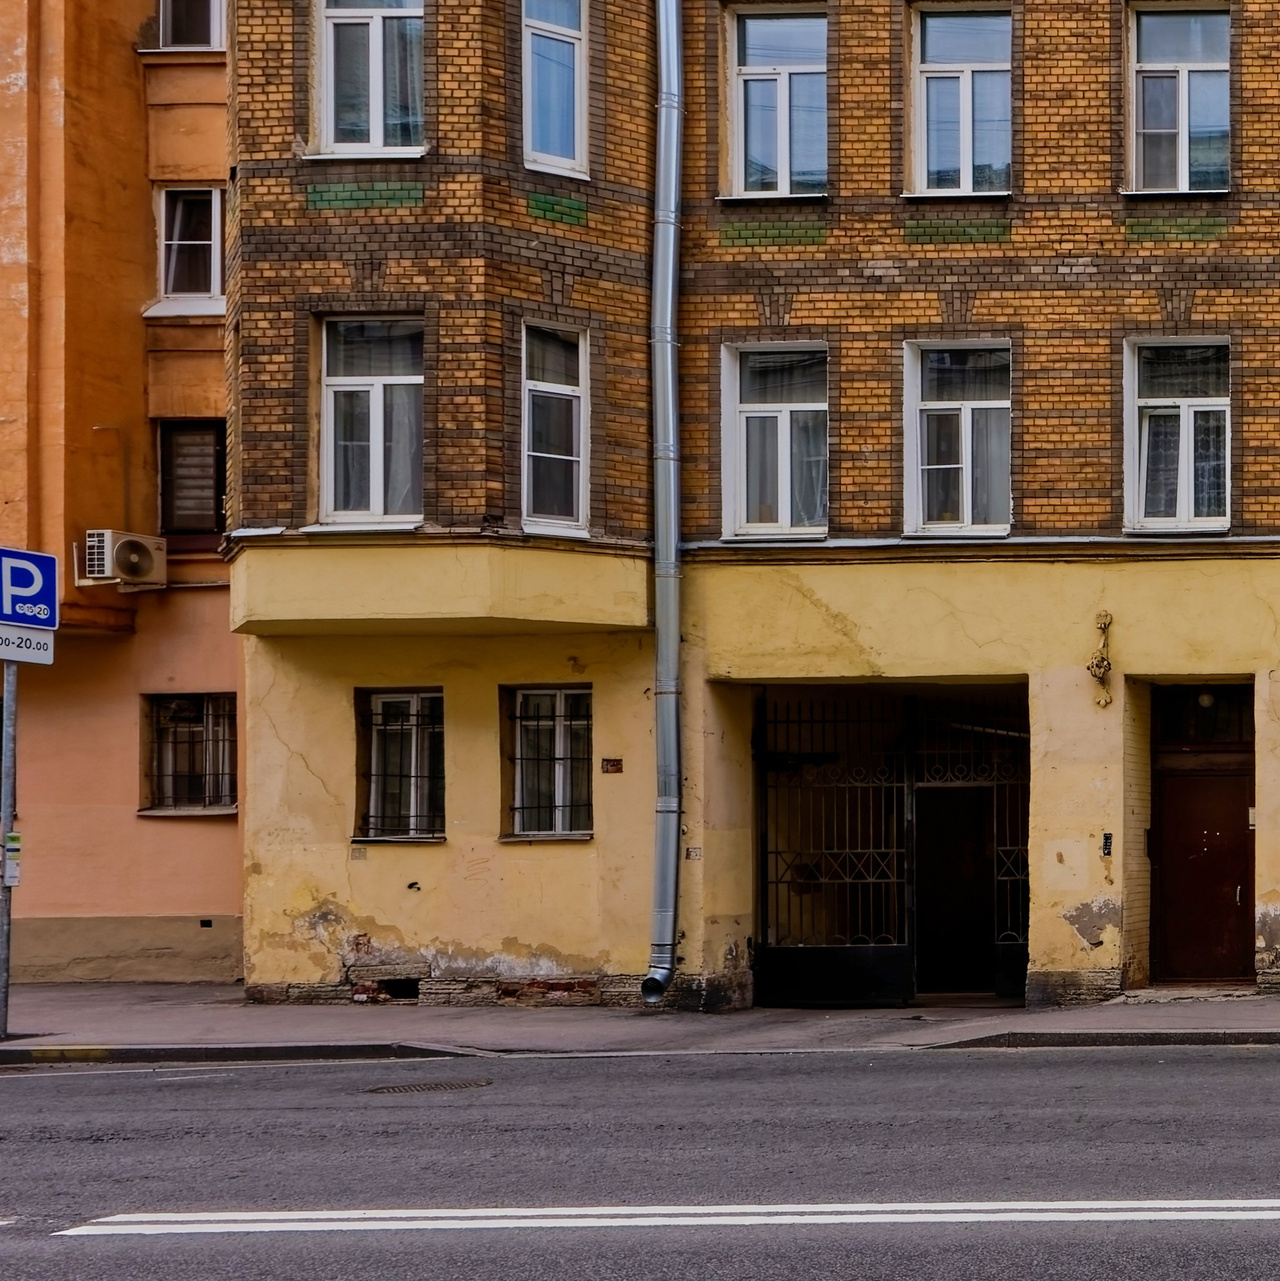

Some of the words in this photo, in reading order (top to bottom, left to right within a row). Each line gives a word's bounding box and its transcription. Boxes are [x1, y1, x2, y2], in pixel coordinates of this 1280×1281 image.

[1, 556, 43, 615] P
[26, 605, 34, 613] 15
[37, 607, 48, 616] 20
